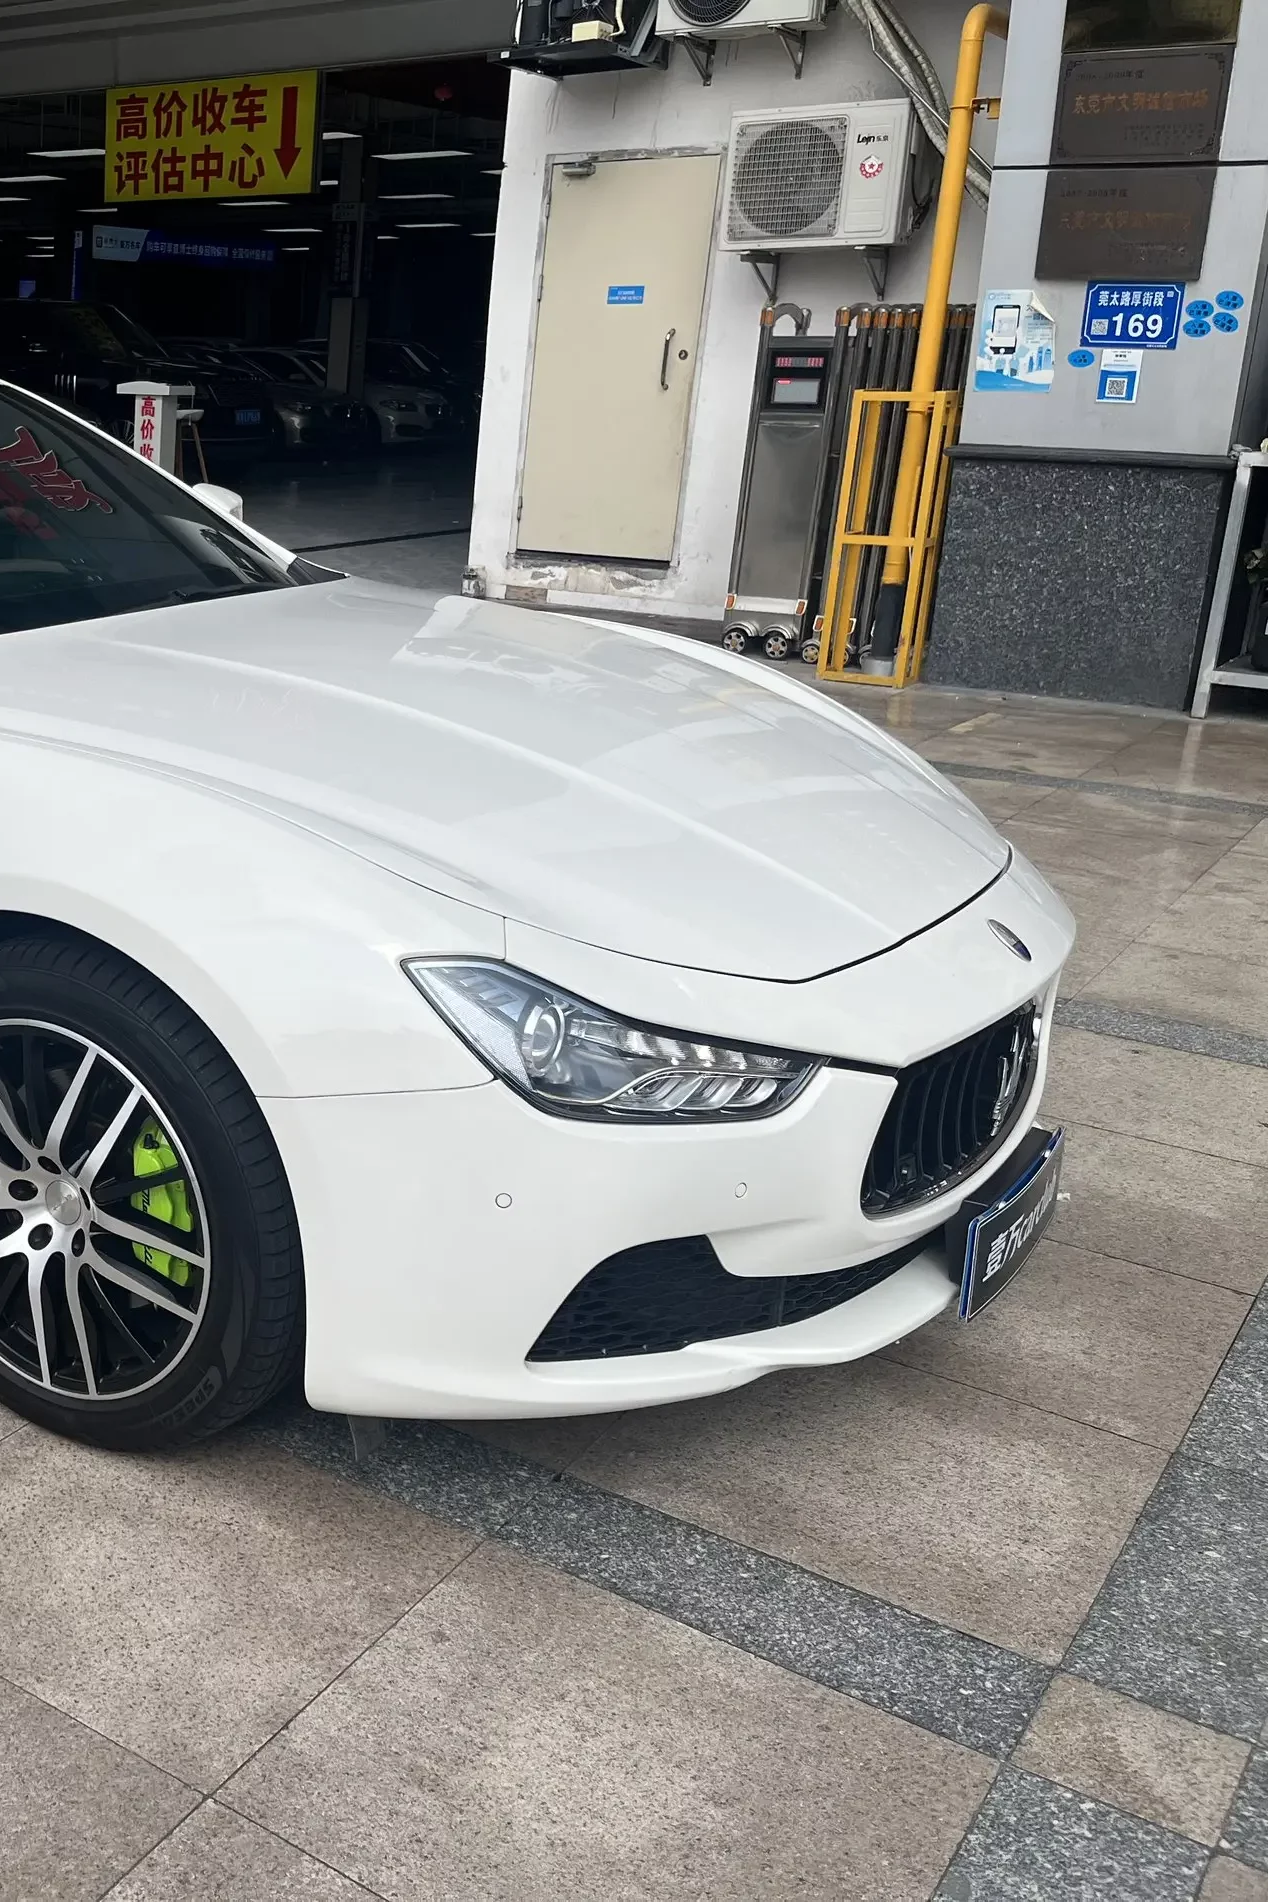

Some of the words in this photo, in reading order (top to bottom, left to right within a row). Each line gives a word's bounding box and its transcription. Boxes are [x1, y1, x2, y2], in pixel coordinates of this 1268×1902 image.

[116, 84, 268, 142] 高价收车
[114, 143, 266, 196] 评估中心
[1097, 290, 1166, 308] 莞太路厚街段
[1111, 312, 1164, 339] 169
